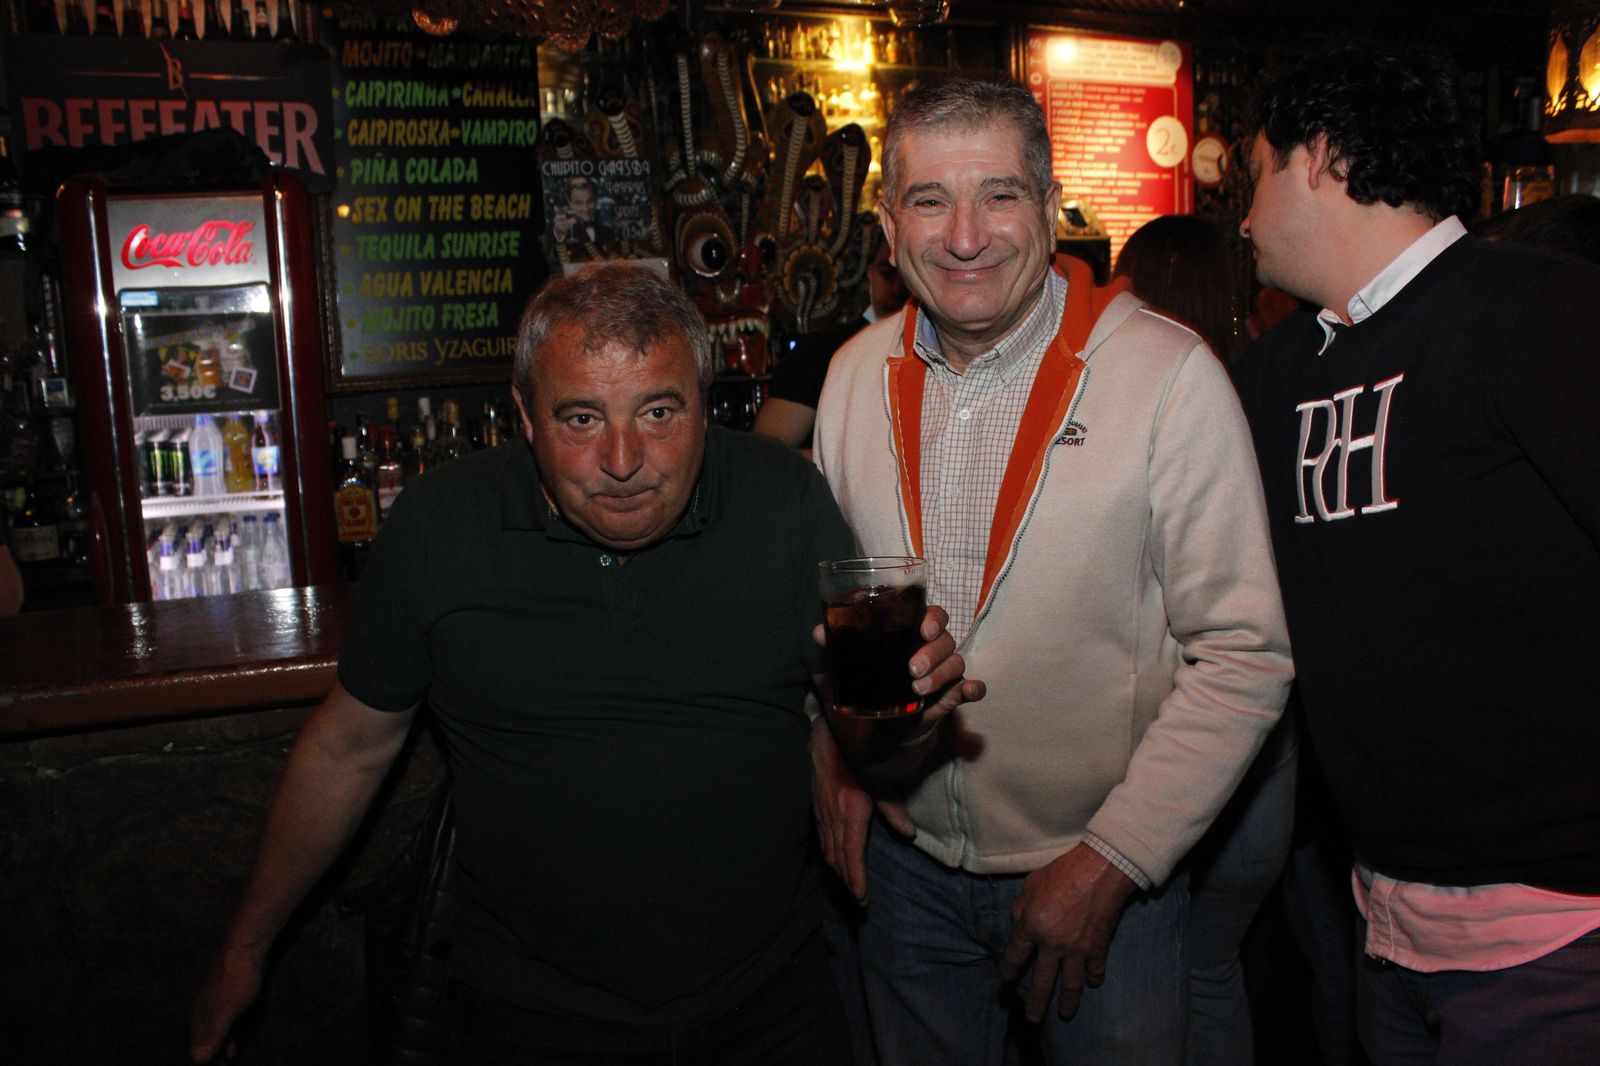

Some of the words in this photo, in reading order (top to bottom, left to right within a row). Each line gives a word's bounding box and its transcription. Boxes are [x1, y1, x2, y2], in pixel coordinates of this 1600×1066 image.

[342, 39, 414, 68] MOJITO
[460, 118, 539, 147] VAMPIRO
[351, 152, 399, 185] PIÑA
[405, 157, 480, 184] COLADA
[352, 196, 388, 224] SEX
[393, 195, 422, 222] ON
[428, 194, 465, 222] THE
[469, 192, 532, 221] BEACH
[356, 232, 436, 263] TEQUILA
[440, 230, 521, 261] SUNRISE
[359, 271, 414, 299] AGUA
[419, 266, 514, 296] VALENCIA
[361, 303, 436, 334] MOJITO
[441, 301, 500, 332] FRESA
[365, 340, 428, 364] BORIS
